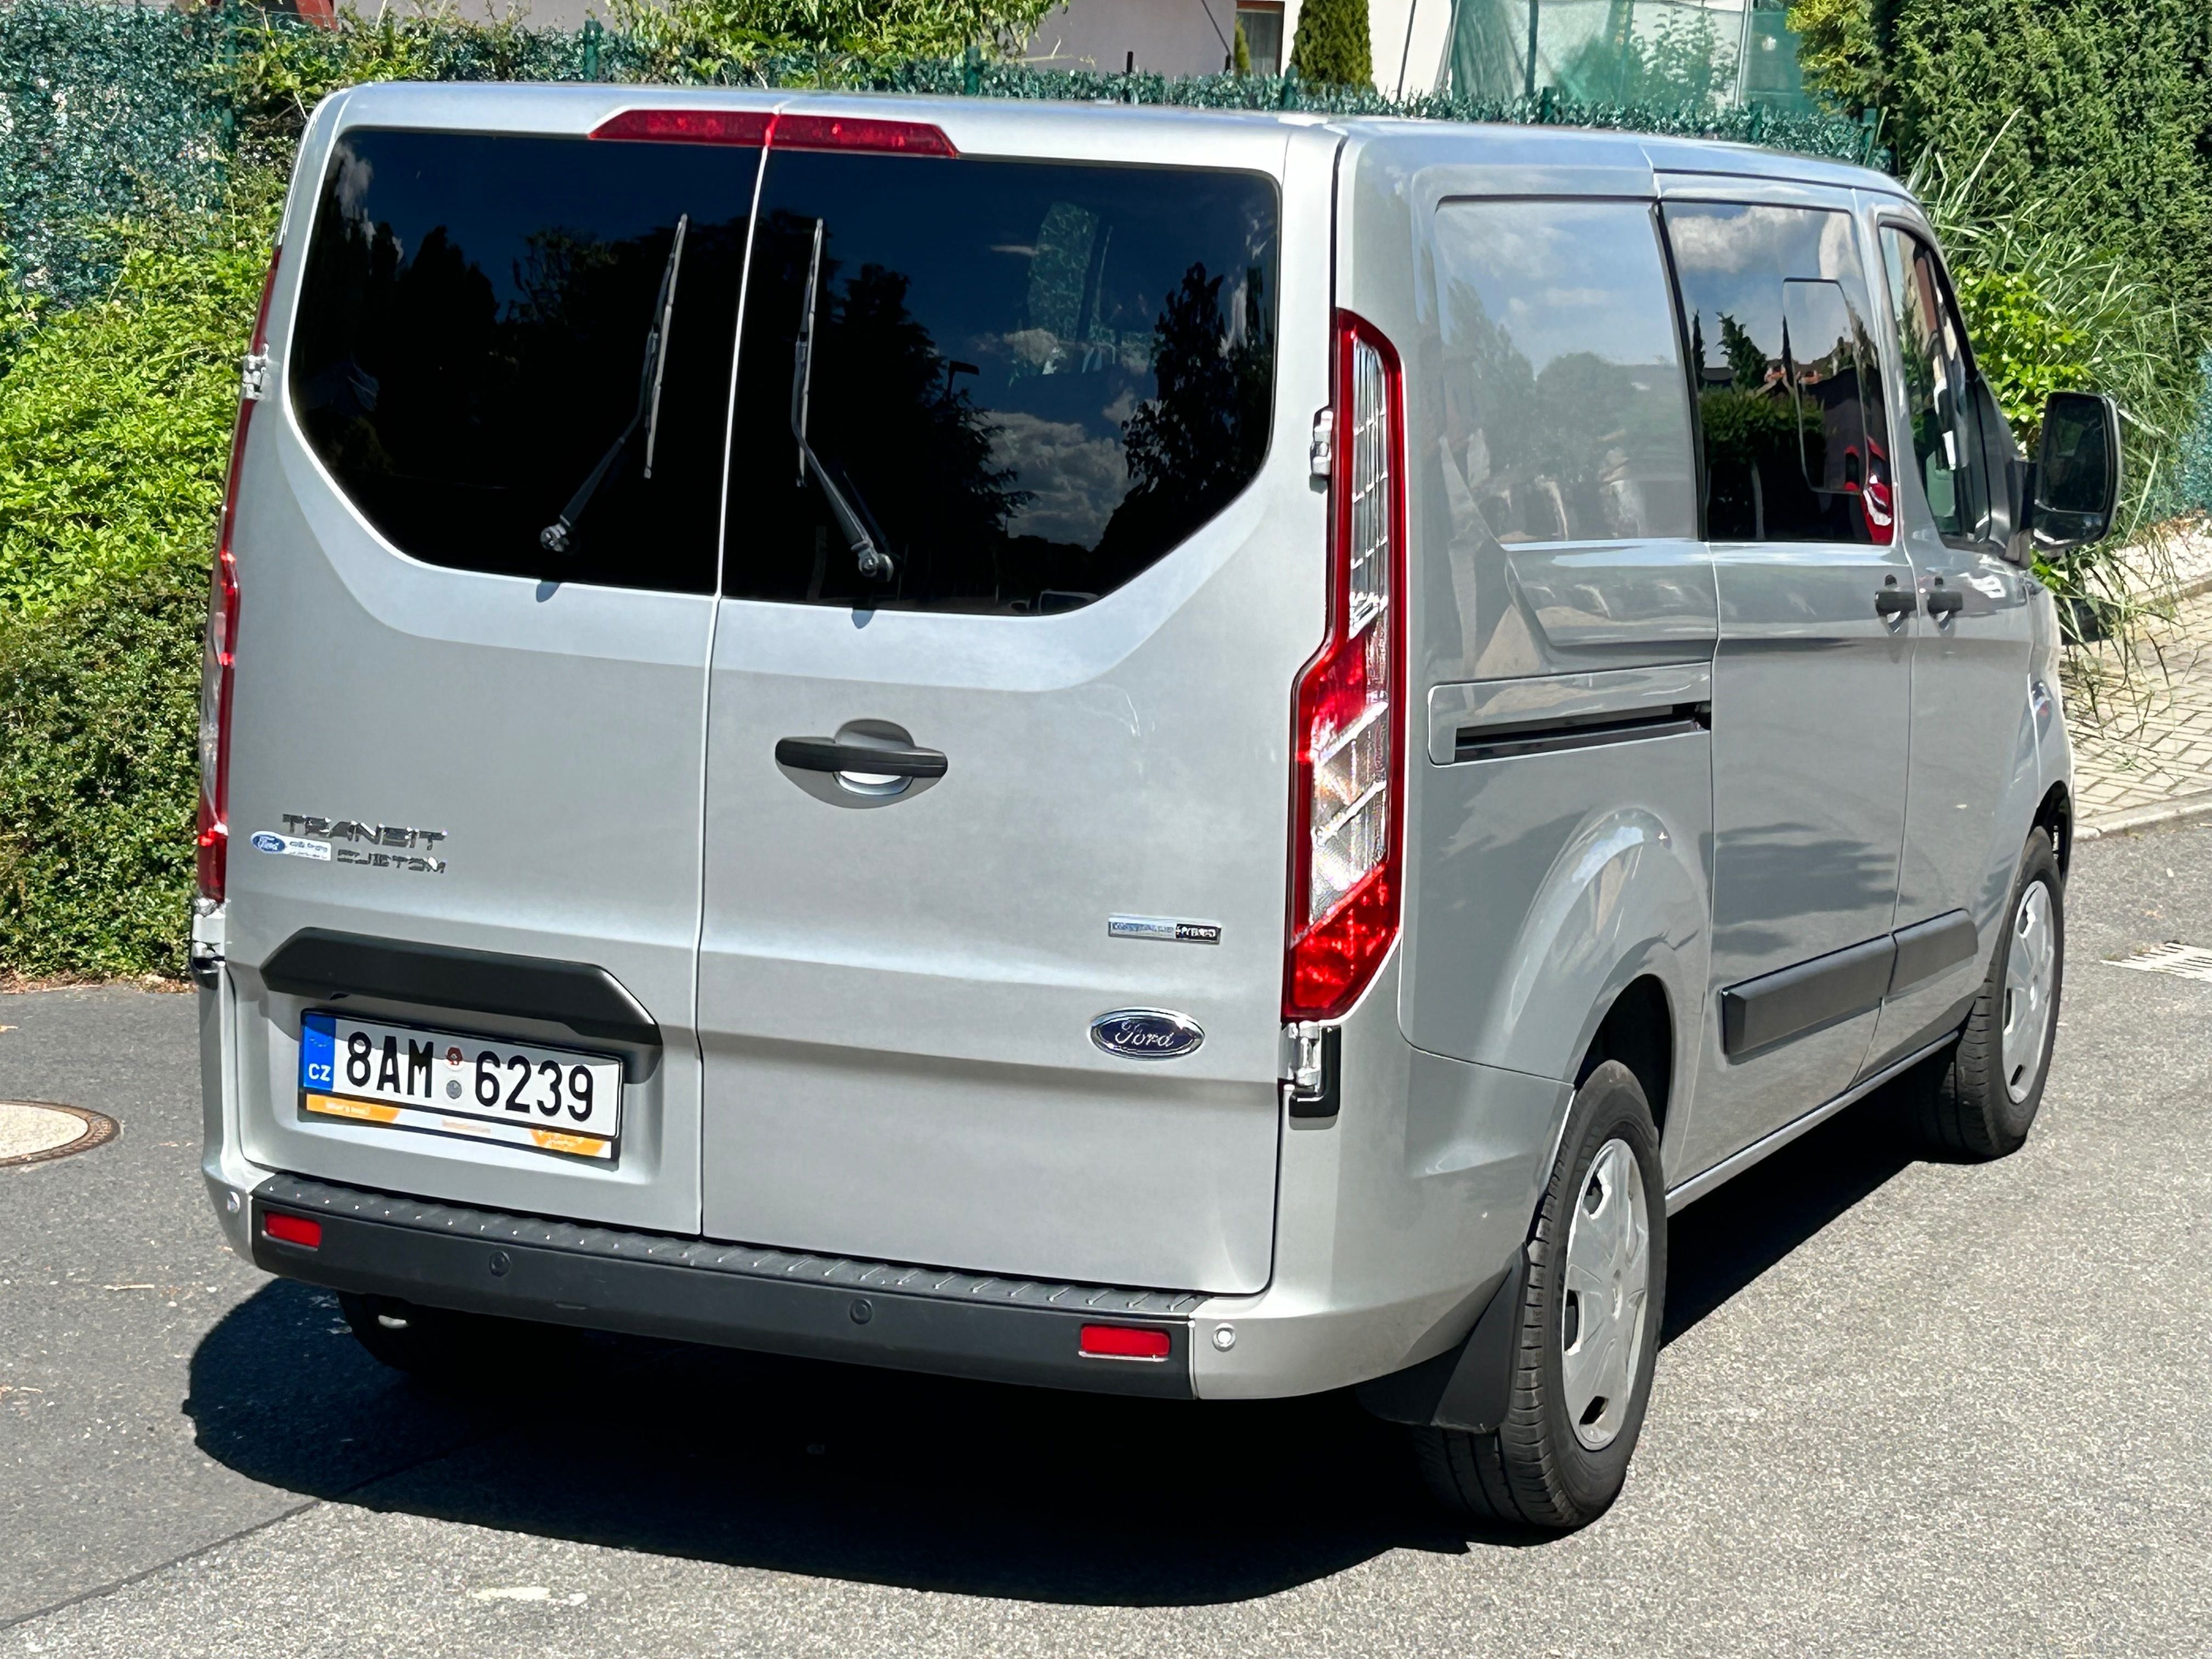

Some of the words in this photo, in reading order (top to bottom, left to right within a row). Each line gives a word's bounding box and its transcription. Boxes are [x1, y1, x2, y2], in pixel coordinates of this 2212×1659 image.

[1115, 1020, 1174, 1047] Ford
[308, 1063, 330, 1082] CZ
[346, 1031, 434, 1098] 8AM
[475, 1051, 594, 1122] 6239
